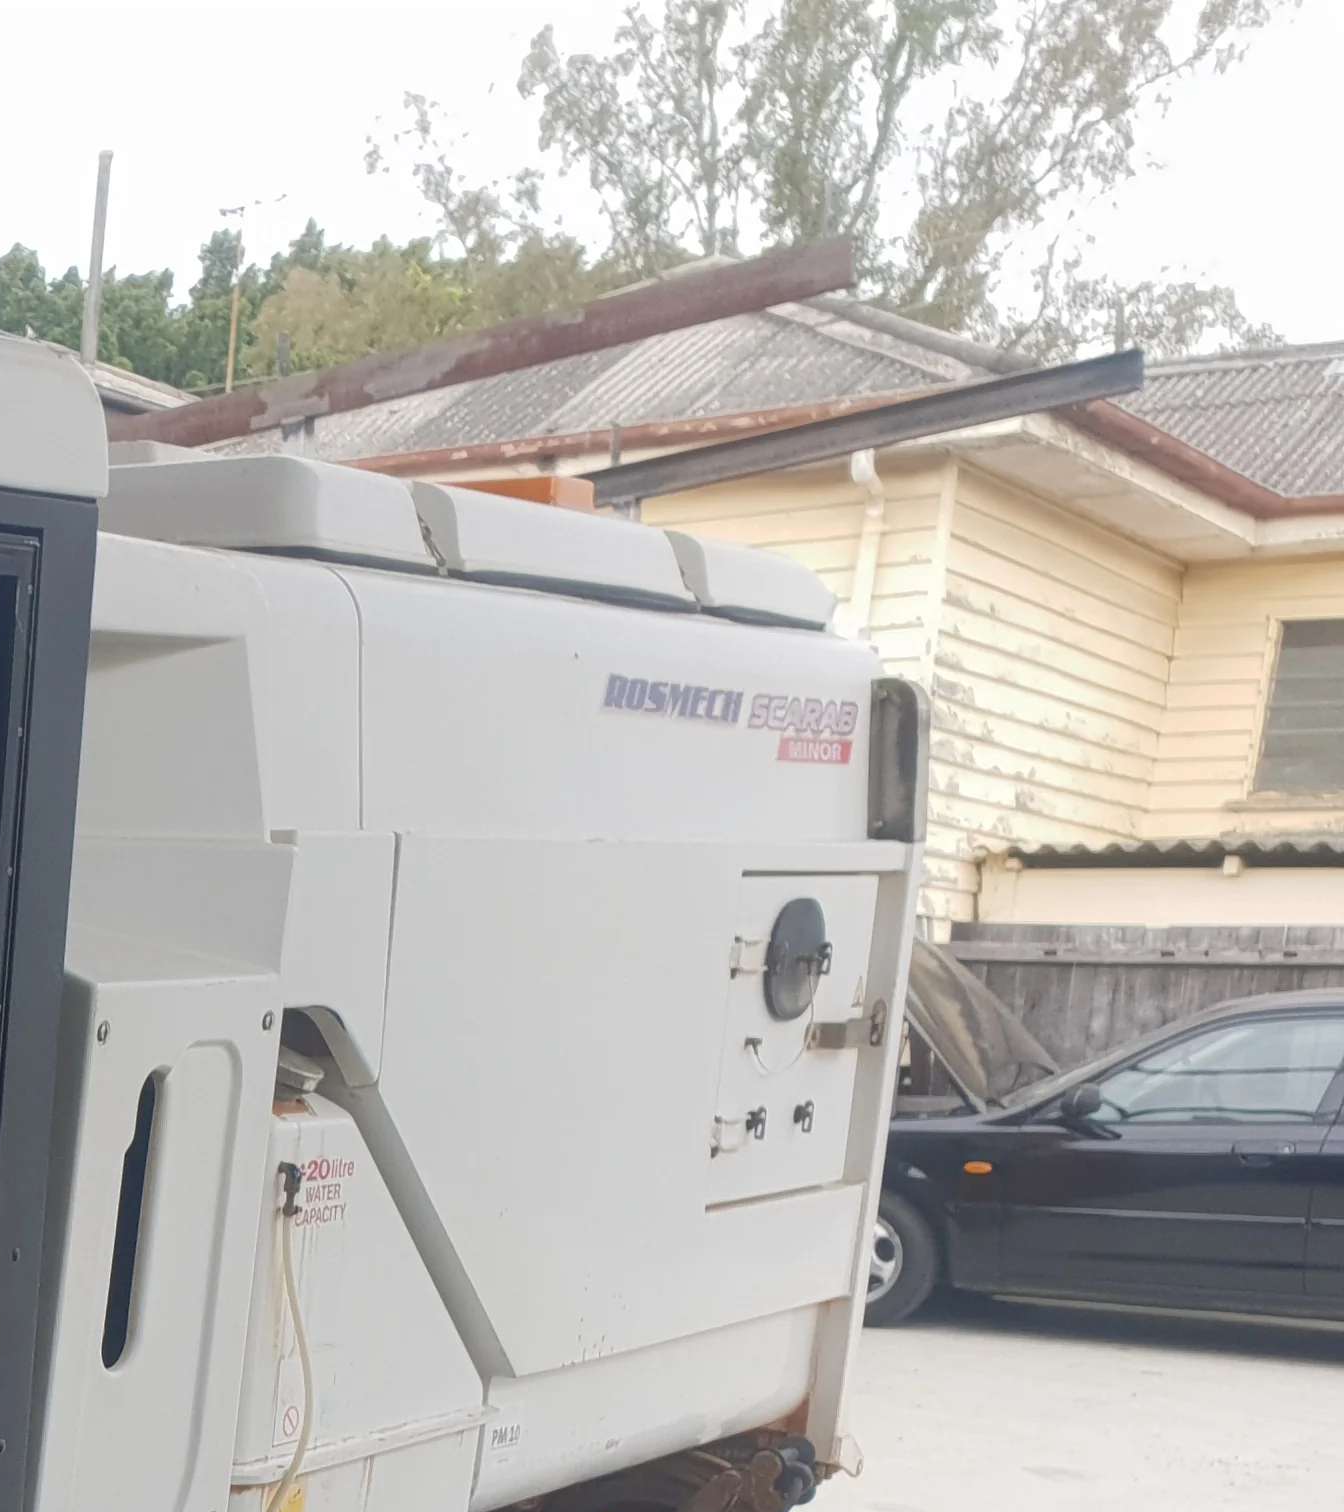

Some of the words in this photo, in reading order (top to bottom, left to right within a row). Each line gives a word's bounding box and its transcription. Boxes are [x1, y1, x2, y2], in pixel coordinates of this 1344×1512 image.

[604, 673, 744, 723] ROSMECH
[748, 694, 859, 736] SCARAB
[786, 738, 842, 763] MINOR
[305, 1183, 341, 1203] WATER
[295, 1202, 347, 1227] CAPACITY
